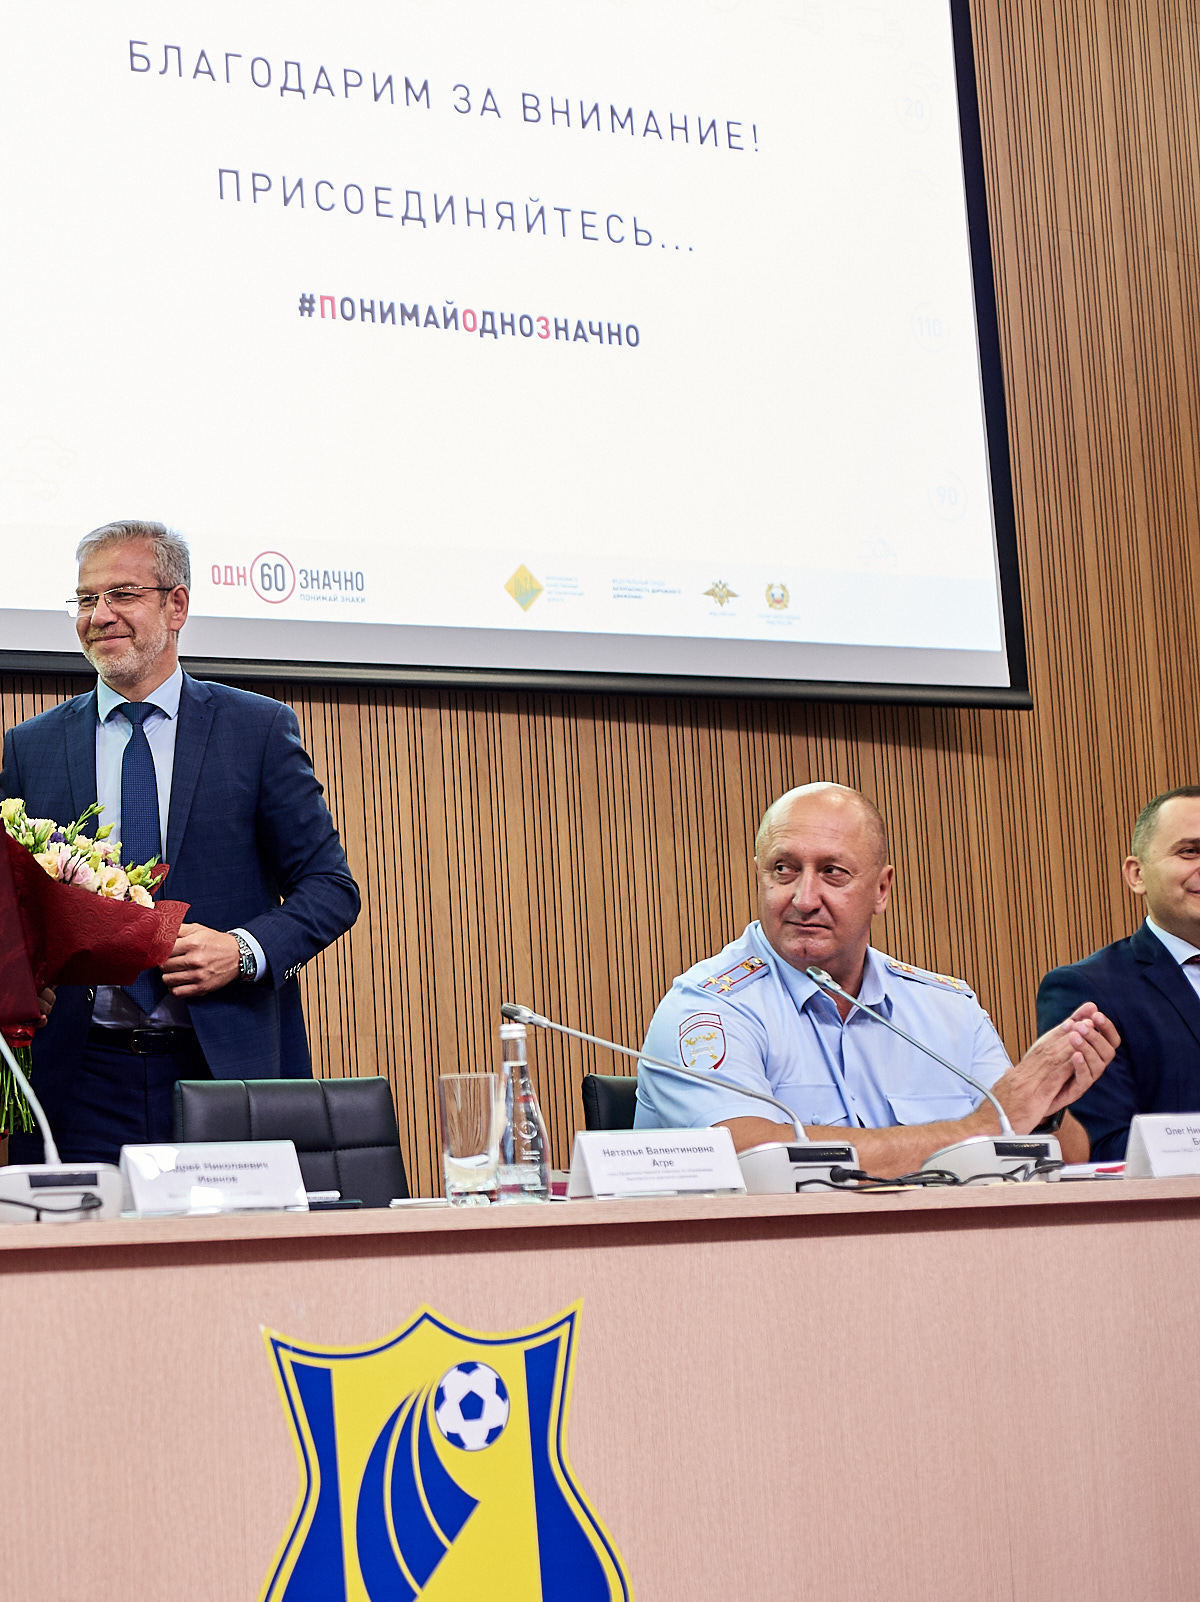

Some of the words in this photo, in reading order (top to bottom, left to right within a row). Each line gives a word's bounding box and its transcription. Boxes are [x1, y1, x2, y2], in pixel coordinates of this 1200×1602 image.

[128, 39, 431, 110] БЛАГОДАРИМ
[452, 83, 502, 119] ЗА
[521, 94, 761, 152] ВНИМАНИЕ!
[218, 168, 695, 252] ПРИСОЕДИНЯЙТЕСЬ...
[297, 292, 641, 349] #ПОНИМАЙОДНОЗНАЧНО
[211, 565, 248, 586] ОДН
[260, 563, 286, 592] 60
[299, 569, 365, 593] ЗНАЧНО
[300, 593, 338, 603] ПОНИМАЙ
[341, 595, 366, 604] ЗНАКИ
[602, 1147, 644, 1158] Наталья
[646, 1145, 715, 1156] Валентиновна
[652, 1158, 675, 1169] Агре
